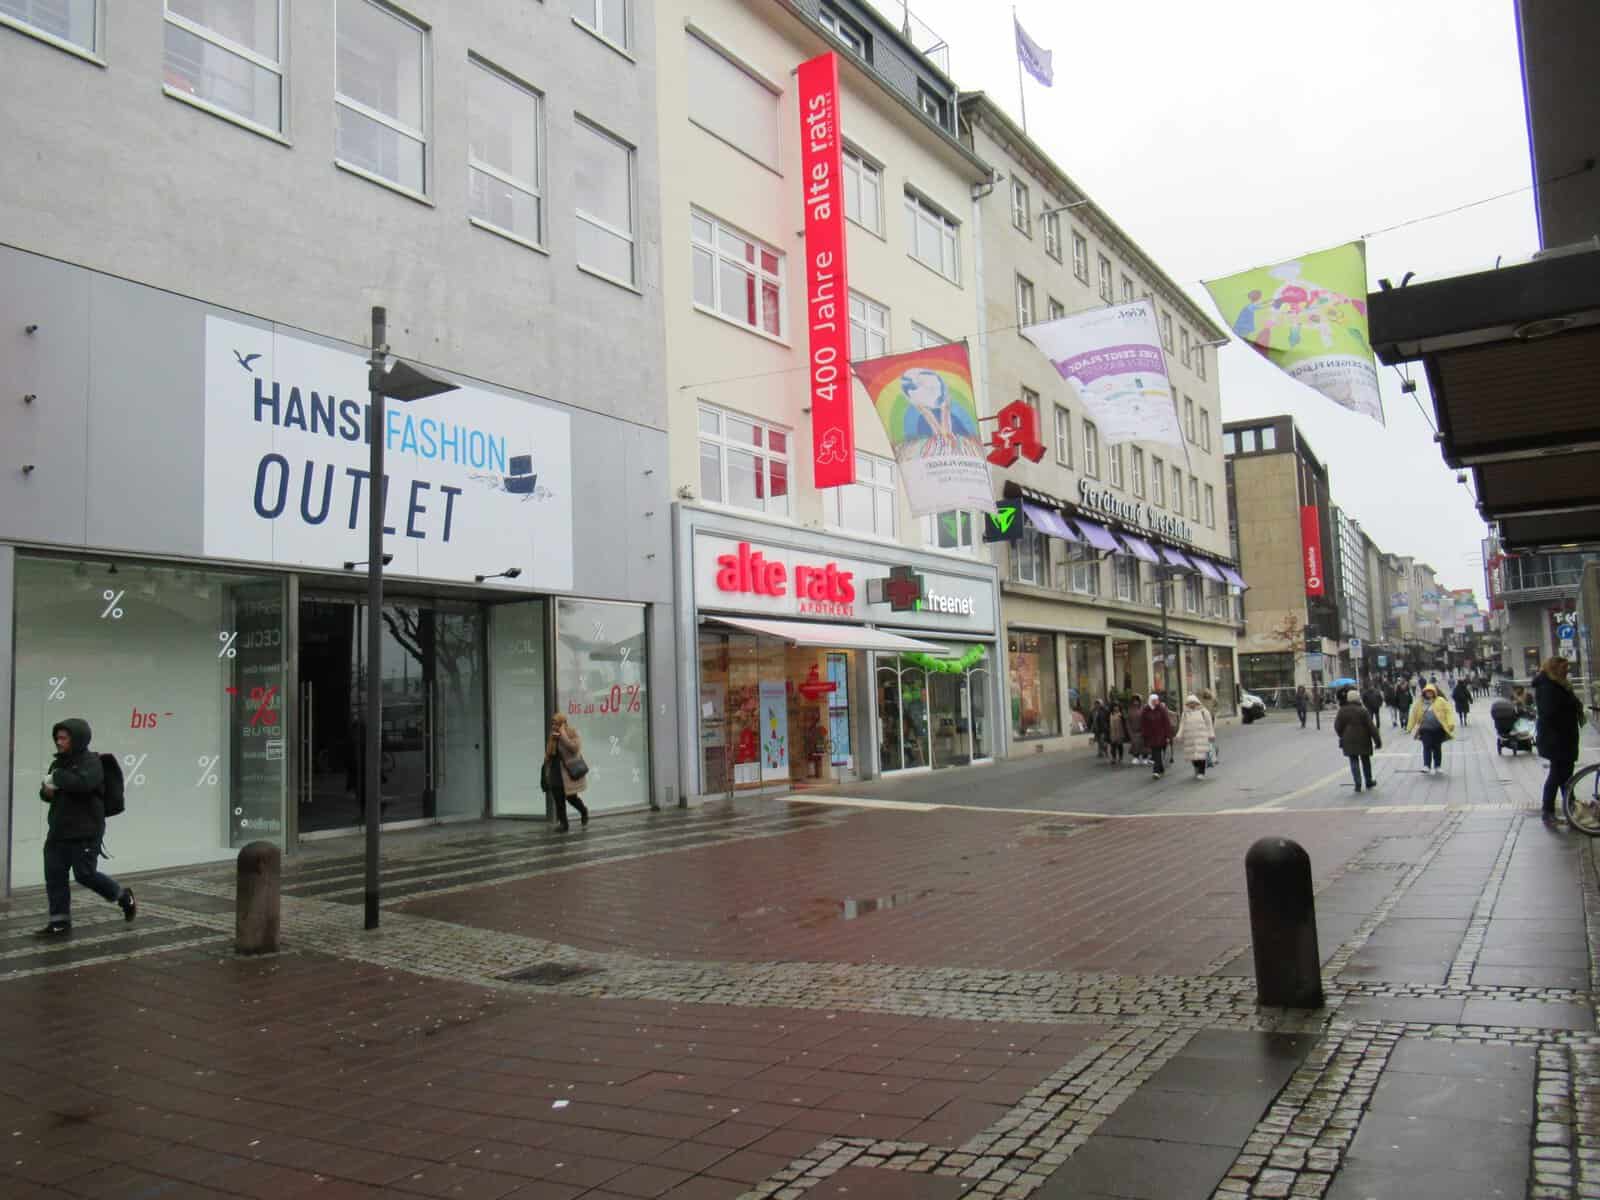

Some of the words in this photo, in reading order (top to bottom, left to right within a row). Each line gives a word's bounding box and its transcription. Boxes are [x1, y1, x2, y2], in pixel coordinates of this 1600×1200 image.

[806, 94, 829, 153] rats
[807, 162, 832, 221] alte
[810, 251, 836, 332] Jahre
[815, 347, 838, 401] 400
[386, 409, 506, 474] FASHION
[253, 452, 462, 543] OUTLET
[716, 541, 788, 597] alte
[795, 563, 856, 605] rats
[927, 589, 975, 615] freenet
[799, 601, 855, 617] APOTHEKE
[130, 706, 158, 729] bis
